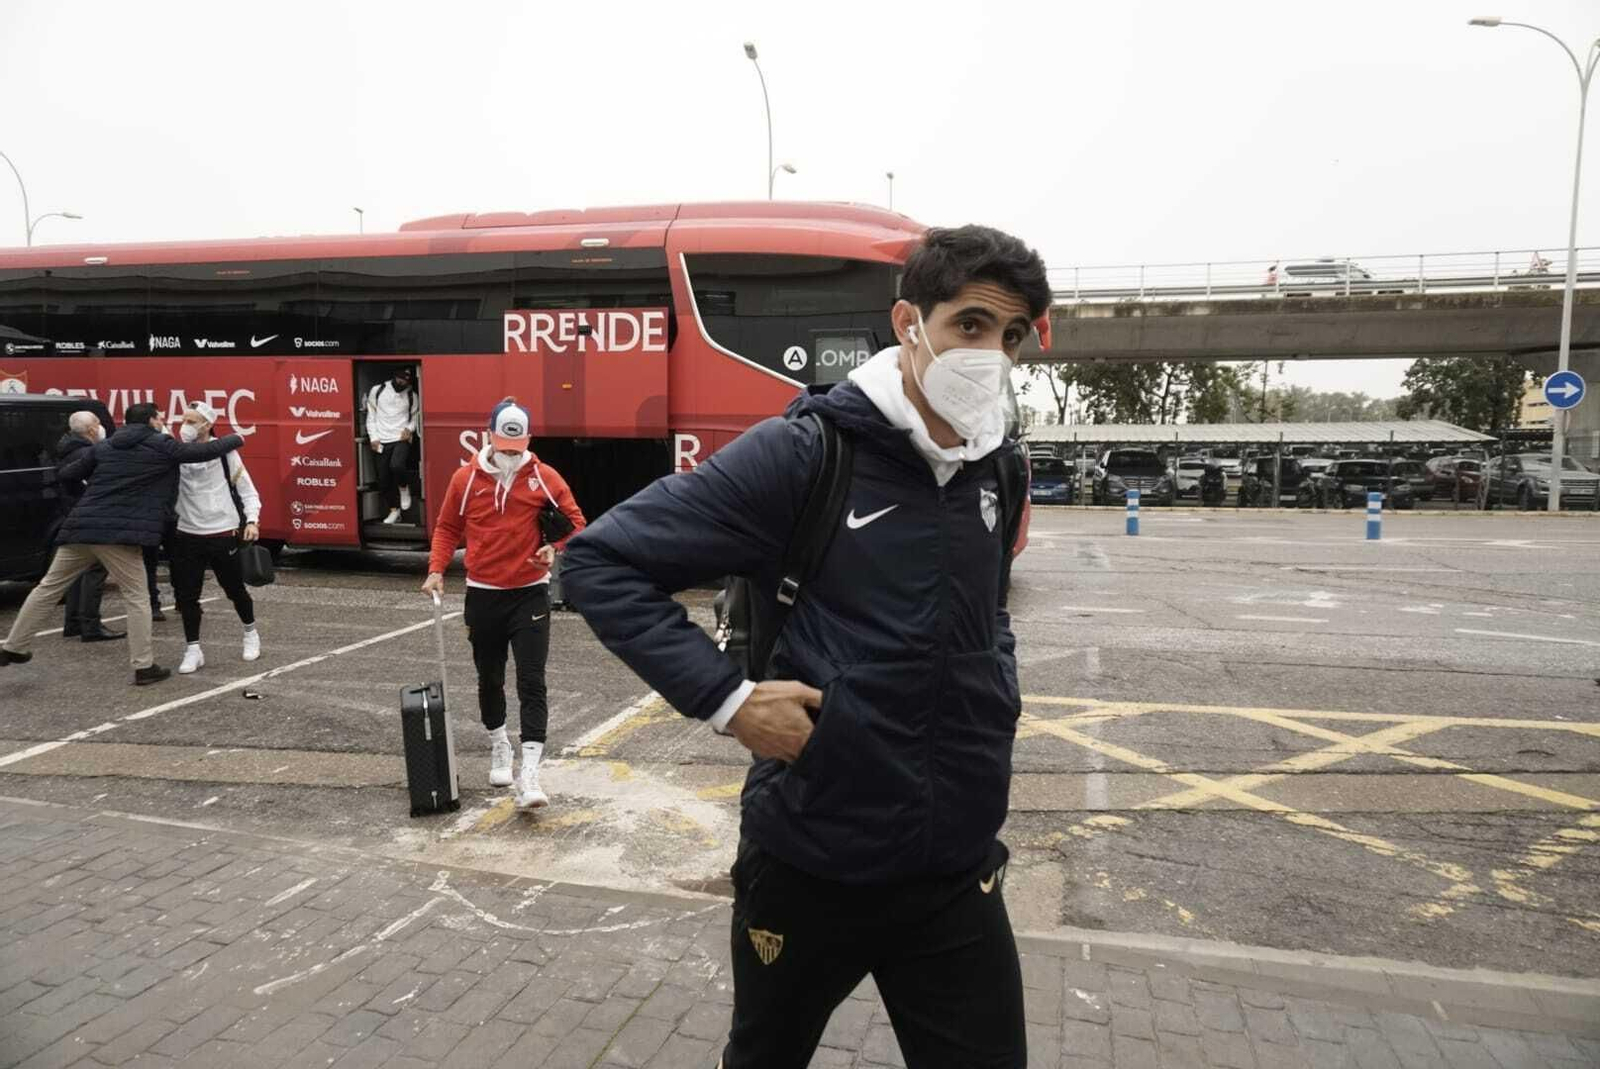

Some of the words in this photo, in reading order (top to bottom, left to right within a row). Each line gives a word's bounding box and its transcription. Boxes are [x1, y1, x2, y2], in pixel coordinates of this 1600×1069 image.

[504, 311, 666, 353] RRENDE
[154, 336, 181, 348] NAGA
[301, 377, 340, 393] NAGA
[306, 409, 341, 419] Valvoline
[302, 456, 342, 468] CaixaBank
[297, 477, 337, 488] ROBLES
[304, 522, 345, 530] socios.com
